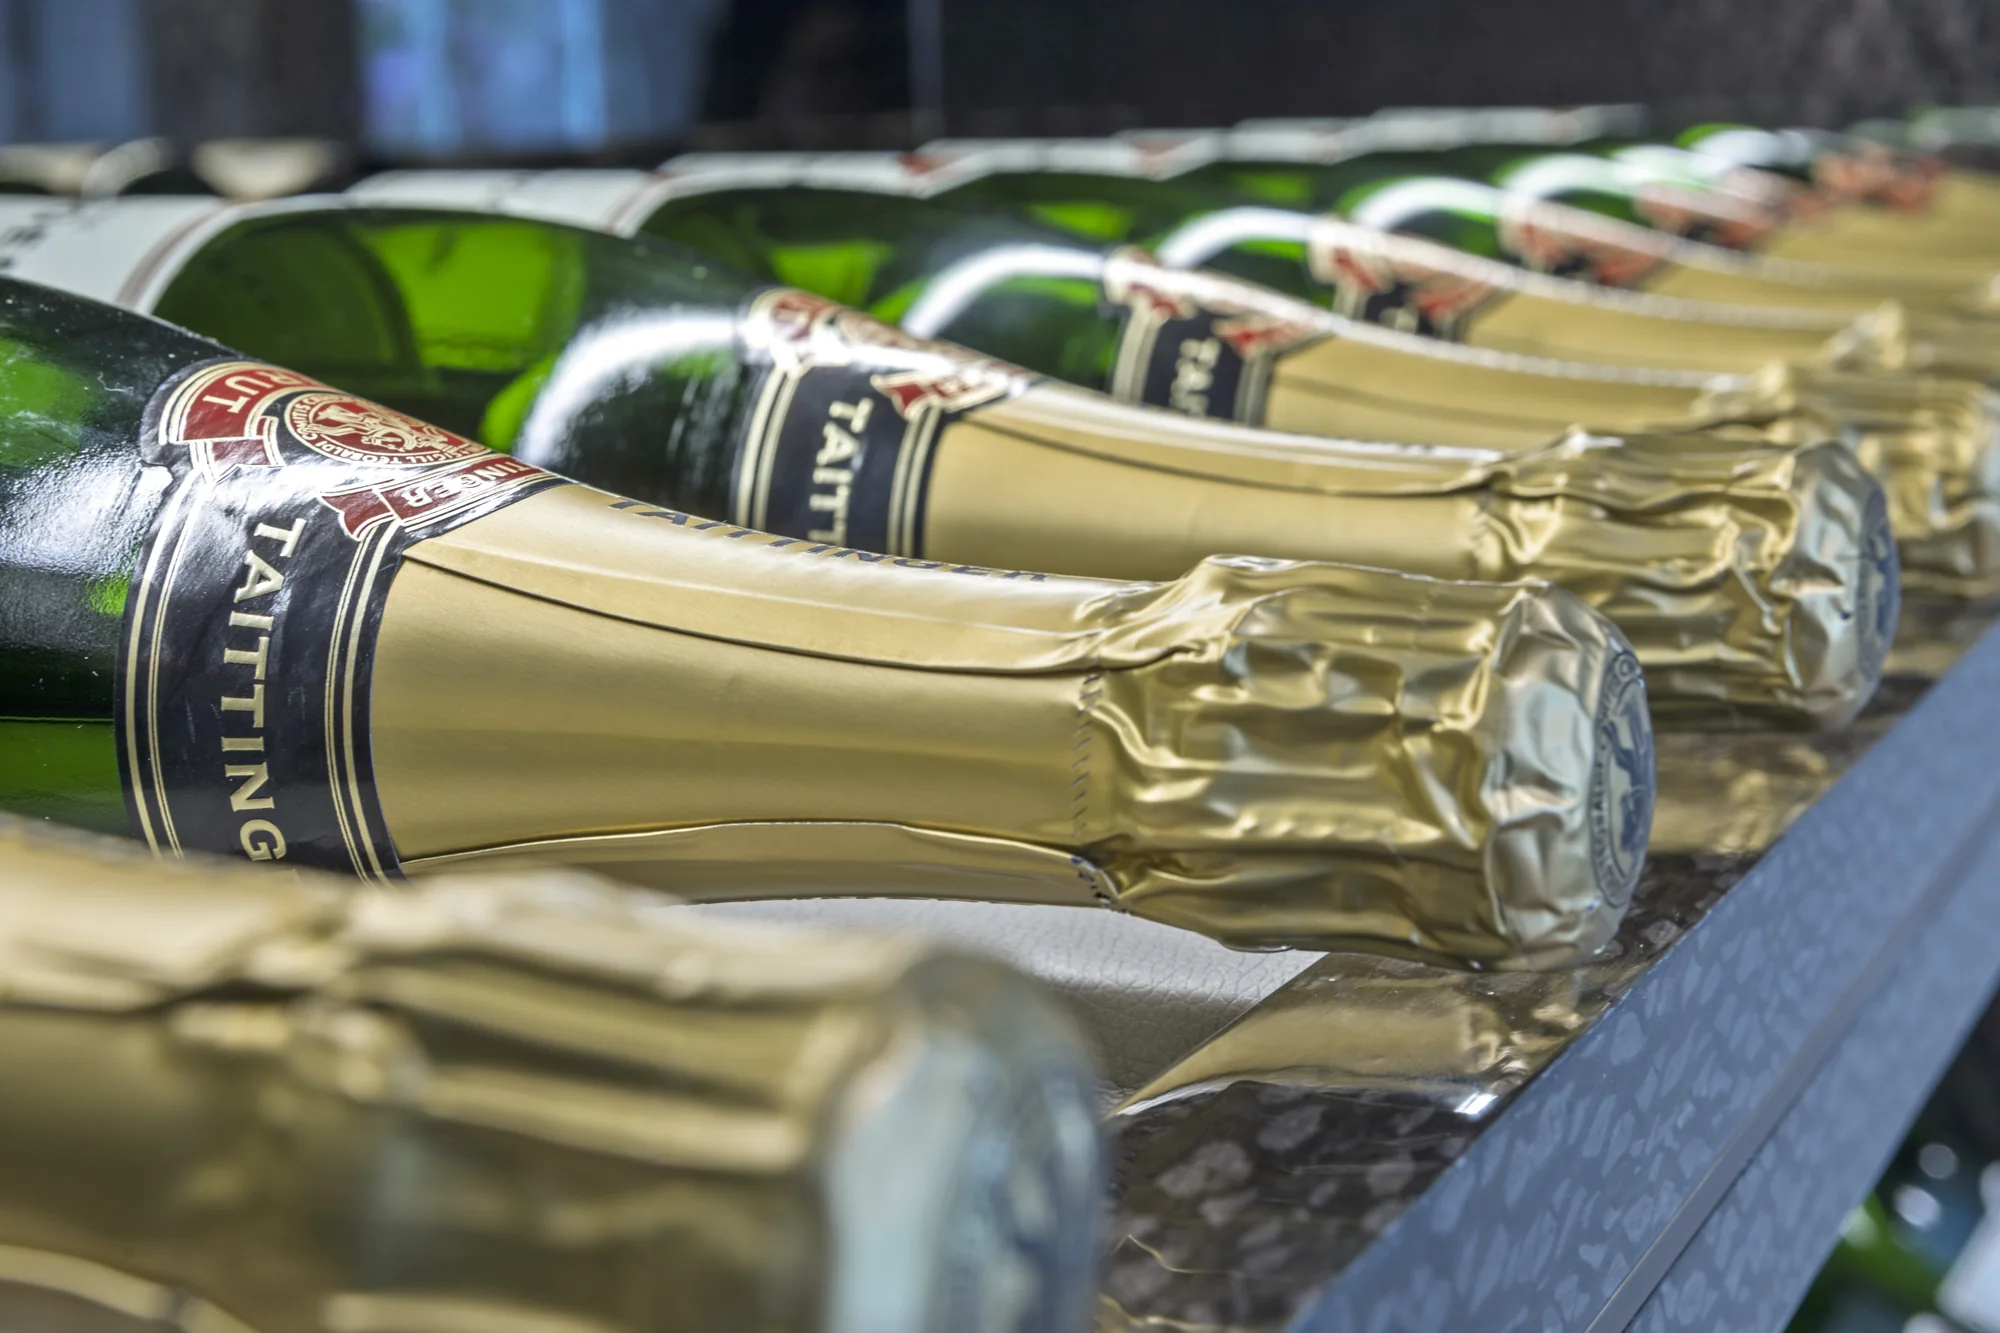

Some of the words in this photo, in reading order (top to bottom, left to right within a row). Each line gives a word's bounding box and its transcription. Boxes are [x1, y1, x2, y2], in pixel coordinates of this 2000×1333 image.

[202, 371, 304, 414] RUT
[400, 461, 531, 507] TINGER
[807, 397, 874, 547] TAITT
[220, 517, 307, 862] TAITTING
